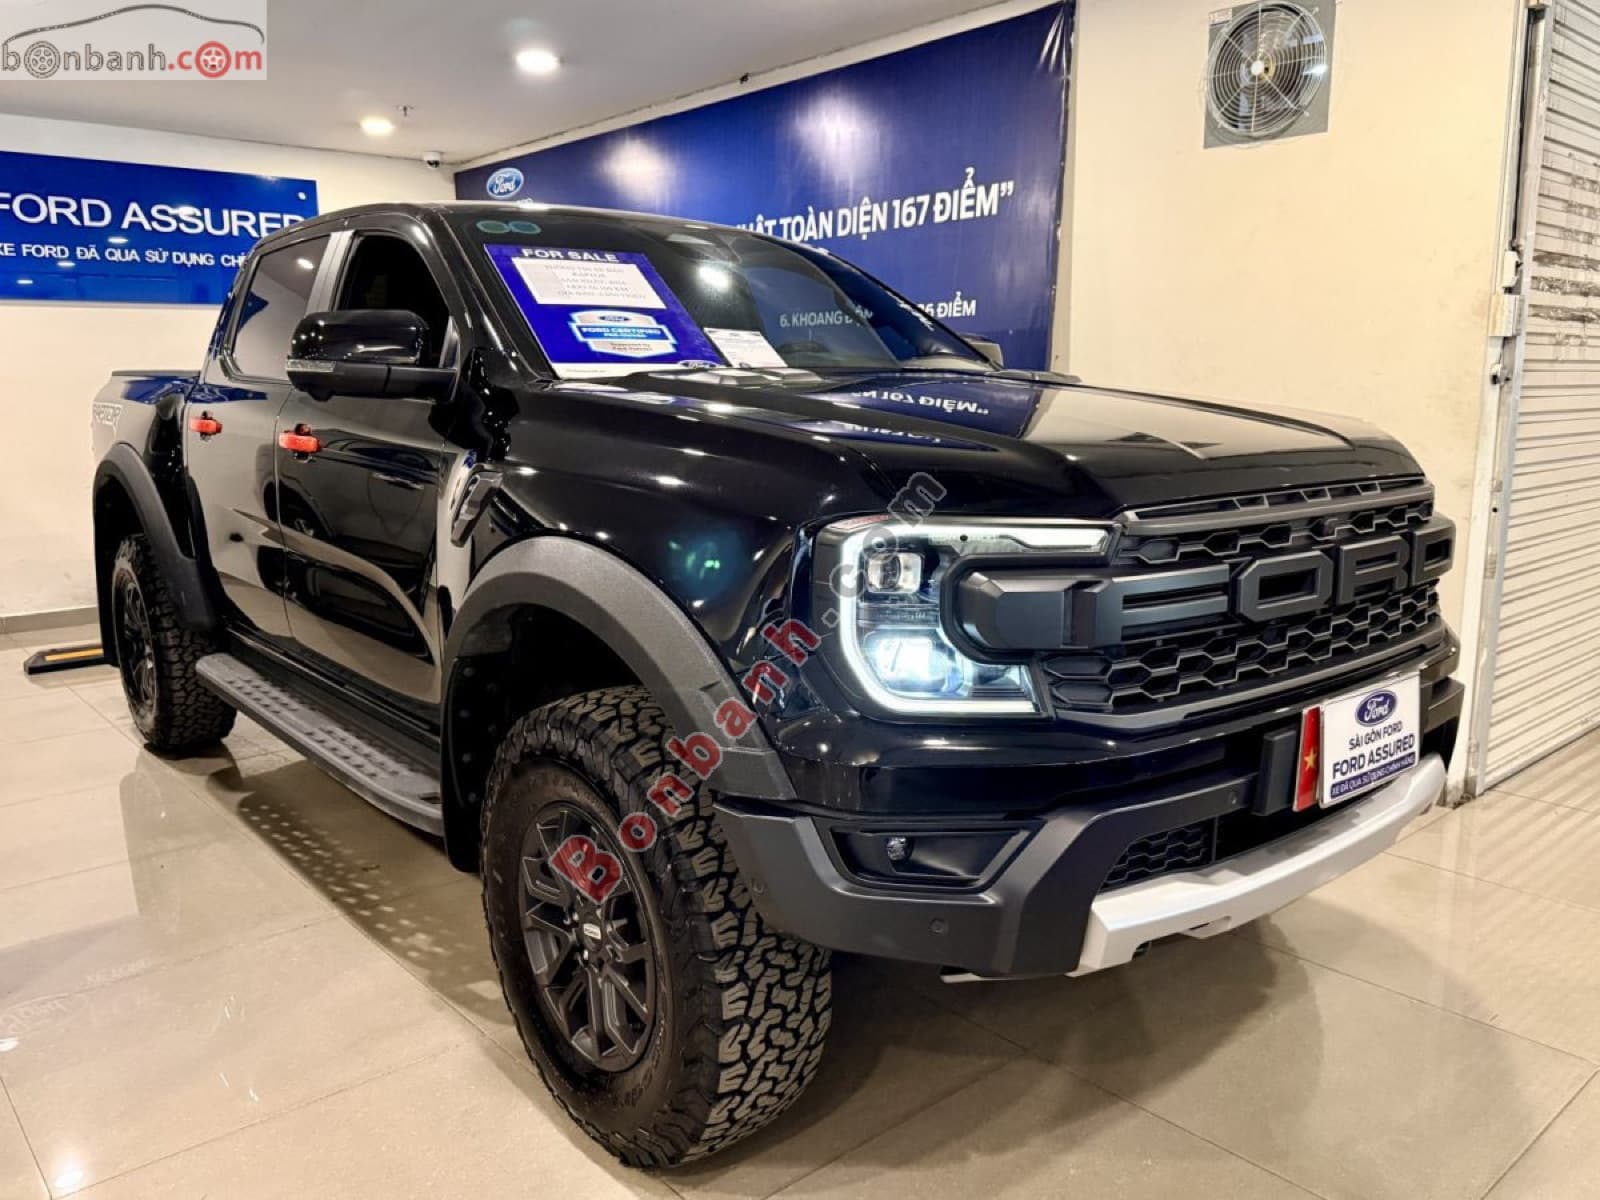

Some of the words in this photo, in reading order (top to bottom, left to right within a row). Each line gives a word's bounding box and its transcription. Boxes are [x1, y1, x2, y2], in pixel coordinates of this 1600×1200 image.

[779, 206, 833, 242] TOÀN
[837, 196, 888, 240] DIỆN
[892, 195, 930, 229] 167
[933, 167, 1014, 224] ĐIỂM”
[21, 243, 69, 259] FORD
[76, 244, 100, 260] ĐÃ
[104, 247, 140, 263] QUA
[145, 246, 169, 263] SỬ
[172, 251, 215, 268] DỤNG
[220, 252, 247, 268] CHÍ
[521, 248, 564, 259] FOR
[567, 251, 620, 263] SALE
[936, 290, 977, 318] ĐIỂM
[779, 314, 791, 328] 6.
[791, 310, 842, 327] KHOANG
[1097, 513, 1456, 648] FORD
[1363, 695, 1391, 722] Ford
[1364, 727, 1381, 745] GÒN
[1383, 720, 1402, 738] FORD
[1333, 753, 1365, 779] FORD
[1367, 733, 1415, 766] ASSURED
